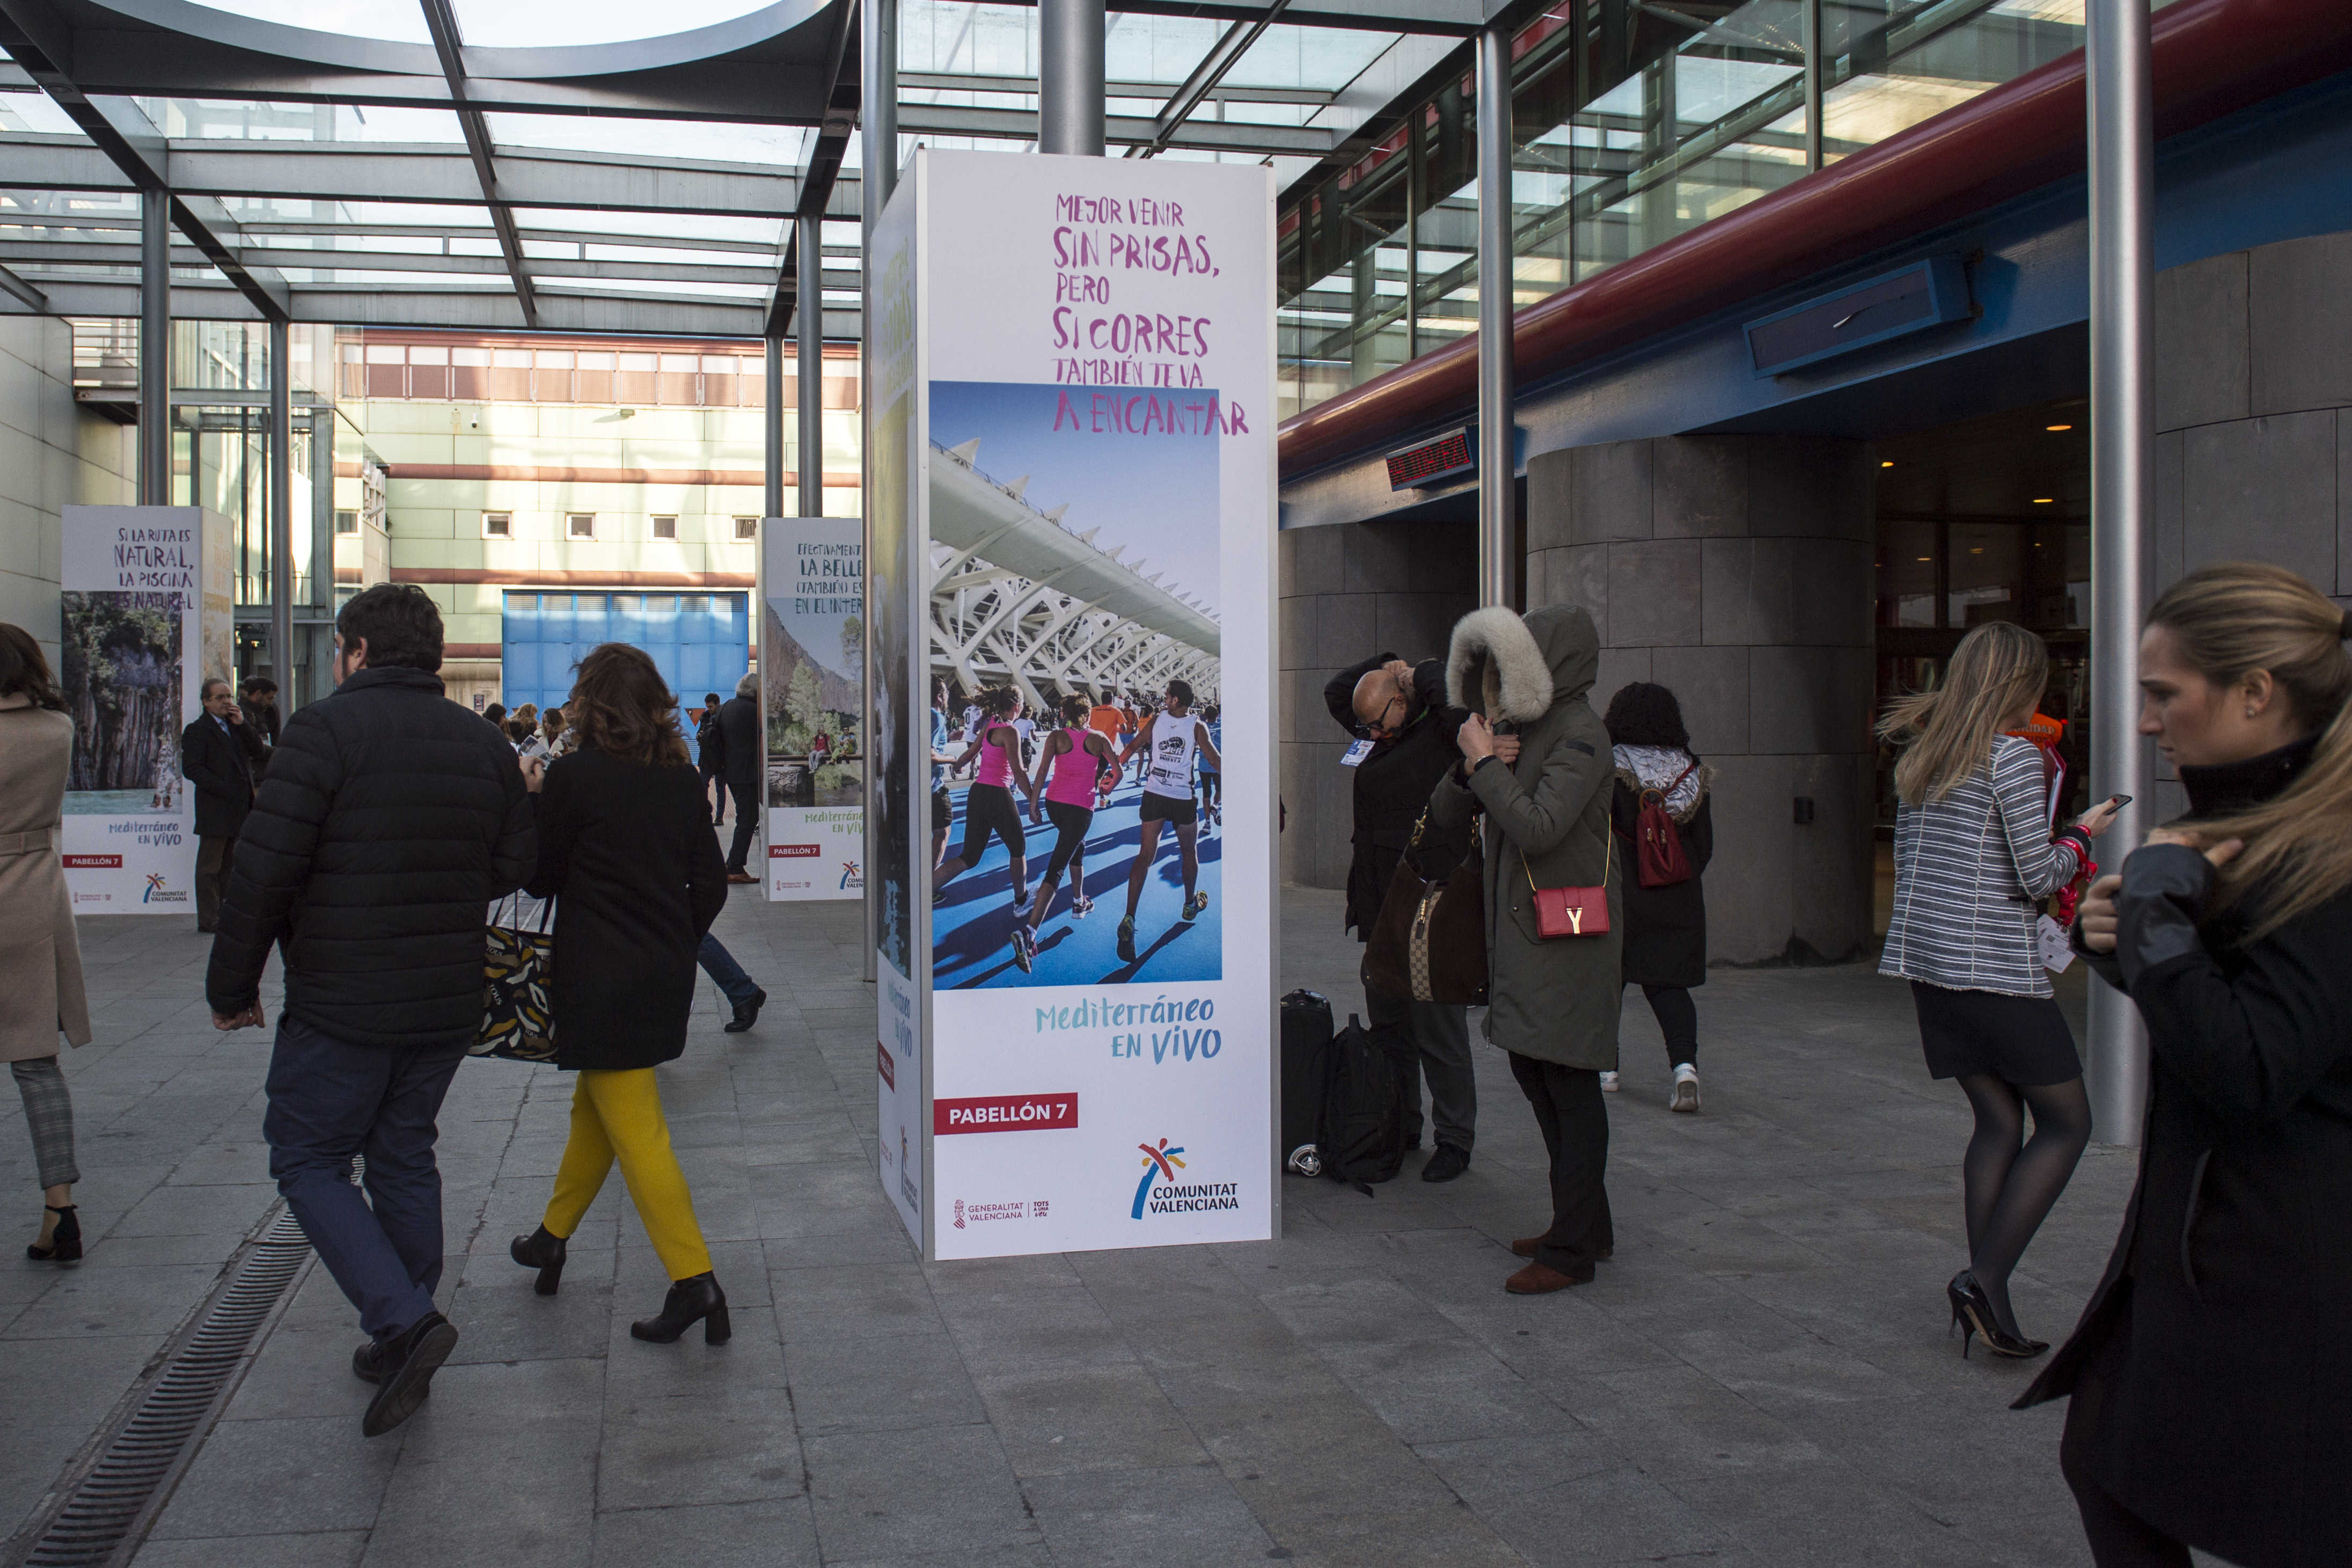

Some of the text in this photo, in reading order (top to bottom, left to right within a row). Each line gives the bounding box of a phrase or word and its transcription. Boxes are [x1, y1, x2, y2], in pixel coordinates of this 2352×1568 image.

[1057, 193, 1184, 227] MEJOR VENIR
[1053, 226, 1220, 278] SIN PRISAS,
[1056, 272, 1110, 304] PERO
[1053, 306, 1211, 357] SI CORRES
[1051, 355, 1204, 389] TAMBIÉN TE VA
[1053, 391, 1249, 436] A ENCANTAR
[132, 529, 145, 543] LA
[148, 529, 175, 542] RUTA
[179, 530, 191, 542] ES
[114, 544, 194, 570] NATURAL,
[801, 559, 818, 576] LA
[119, 571, 193, 588] LA PISCINA
[796, 580, 848, 595] (TAMBIÉN)
[135, 591, 194, 610] NATURAL
[795, 598, 809, 614] EN
[814, 598, 827, 614] EL
[832, 824, 844, 833] EN
[138, 835, 150, 844] EN
[774, 846, 811, 854] PABELLÓN
[72, 857, 112, 865] PABELLÓN
[489, 984, 502, 1005] TOUS
[1036, 995, 1214, 1033] Mediterráneo
[1111, 1034, 1141, 1058] EN
[949, 1102, 1067, 1125] PABELLÓN 7
[1153, 1183, 1238, 1199] COMUNITAT
[968, 1202, 1024, 1213] GENERALITAT
[1149, 1197, 1239, 1213] VALENCIANA
[969, 1212, 1022, 1221] VALENCIANA
